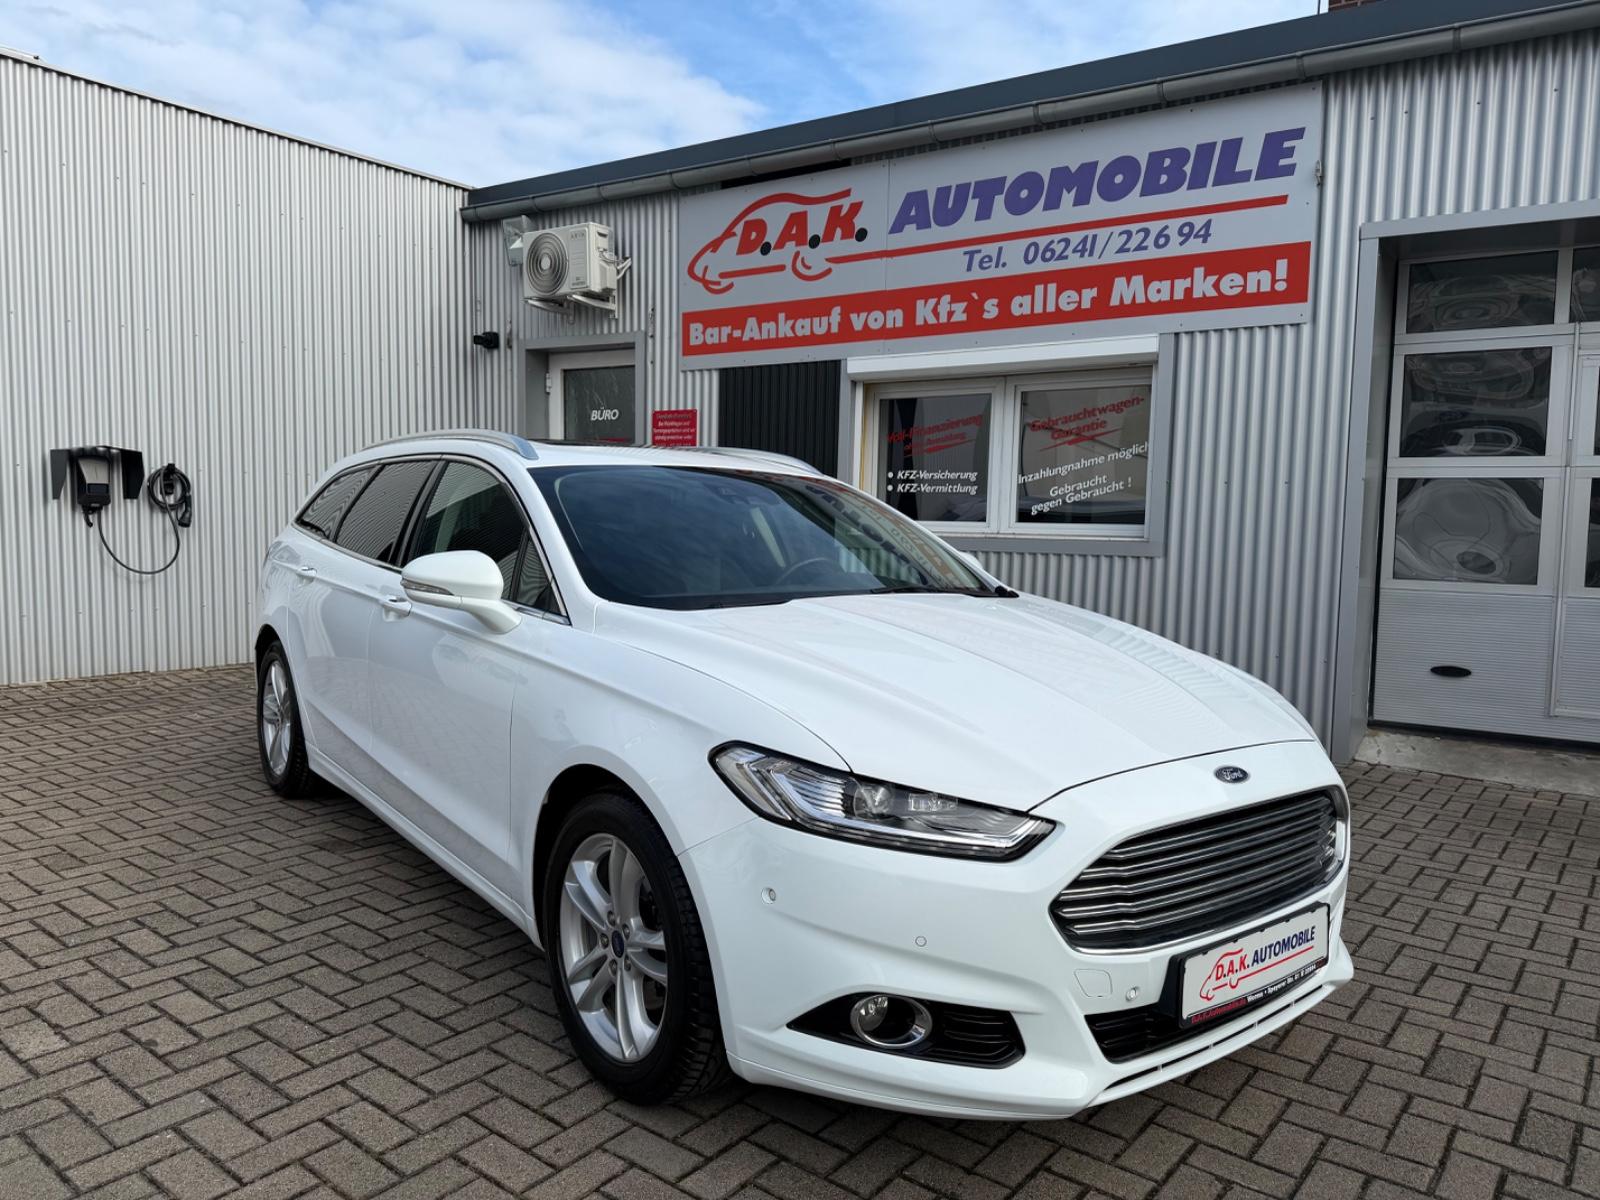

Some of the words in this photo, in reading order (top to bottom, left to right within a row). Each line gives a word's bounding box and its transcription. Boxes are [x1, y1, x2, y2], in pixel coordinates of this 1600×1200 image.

[736, 201, 868, 256] D.A.K.
[888, 127, 1306, 235] AUTOMOBILE
[963, 246, 1007, 272] Tel.
[689, 306, 841, 346] Bar-Ankauf
[851, 307, 904, 332] von
[1010, 283, 1098, 317] aller
[1110, 259, 1288, 307] Marken!
[591, 406, 620, 421] BÜRO
[1030, 396, 1144, 432] Gebrauchtwagen-
[1051, 418, 1108, 440] Garantie
[896, 469, 978, 482] KFZ-Versicherung
[1018, 454, 1106, 484] Inzahlungnahme
[896, 483, 978, 496] KFZ-Vermittlung
[1031, 498, 1062, 516] gegen
[1065, 481, 1125, 504] Gebraucht
[1050, 474, 1108, 497] Gebraucht
[1215, 953, 1250, 981] D.A.K.
[1251, 925, 1316, 967] AUTOMOBILE
